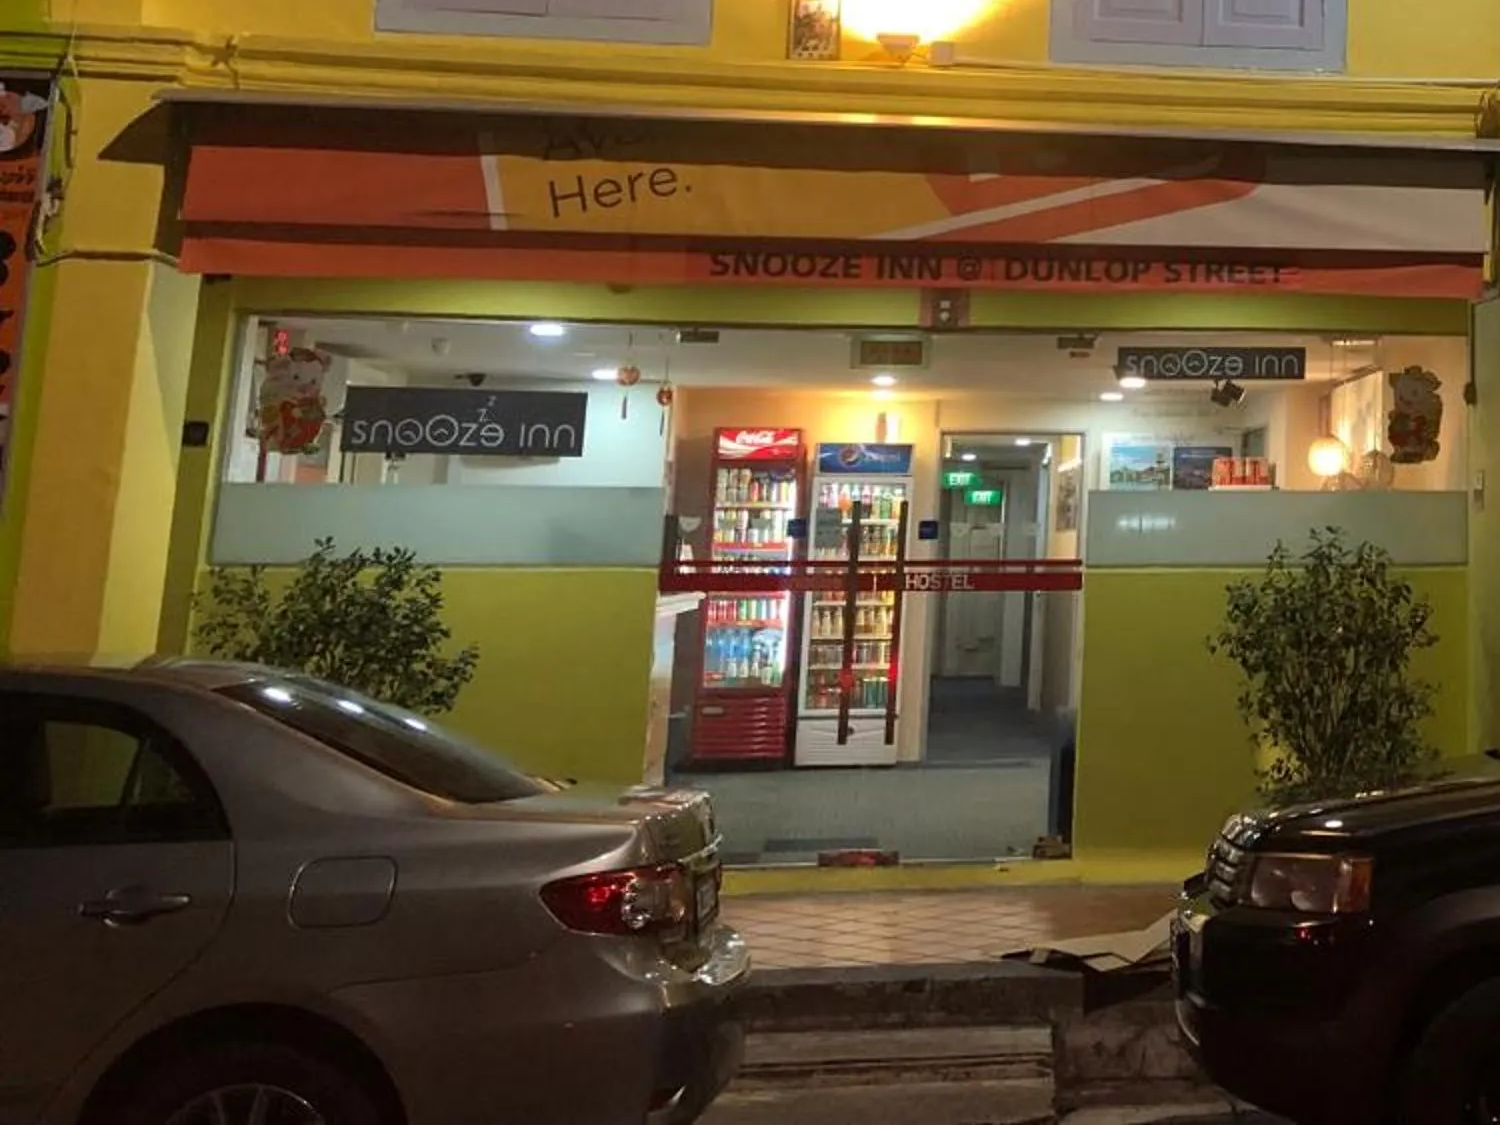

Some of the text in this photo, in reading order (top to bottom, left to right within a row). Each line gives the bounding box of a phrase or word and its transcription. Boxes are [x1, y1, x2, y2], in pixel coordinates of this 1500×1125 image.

[548, 167, 692, 219] Here.
[708, 251, 1283, 284] SNOOZE INN @ DUNLOP STREET
[904, 573, 974, 590] HOSTEL
